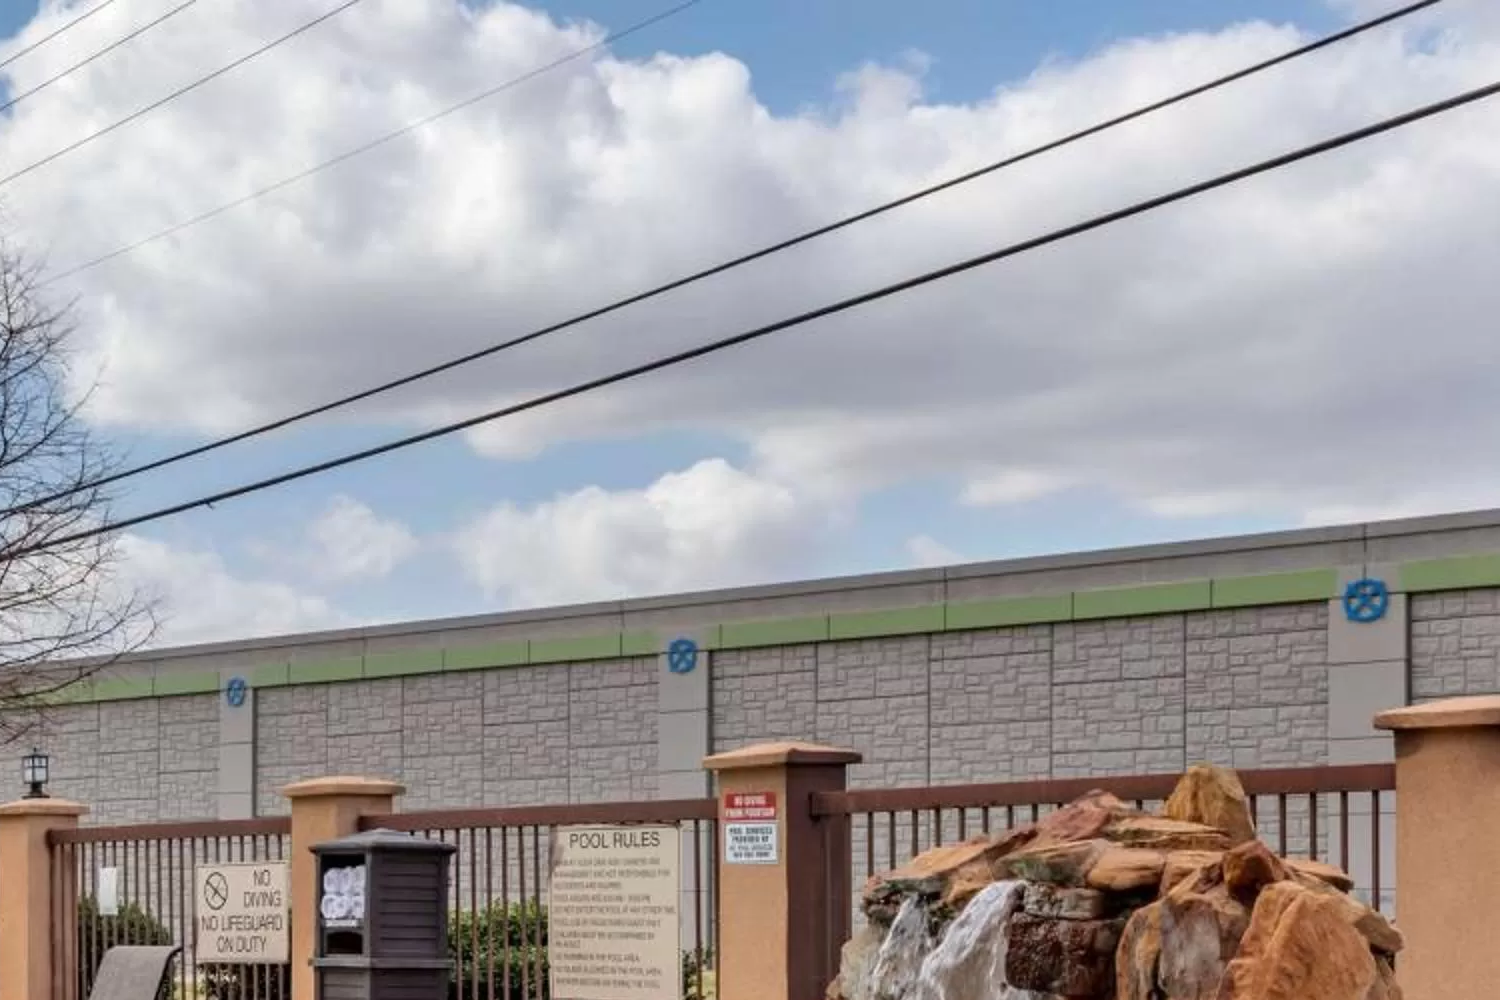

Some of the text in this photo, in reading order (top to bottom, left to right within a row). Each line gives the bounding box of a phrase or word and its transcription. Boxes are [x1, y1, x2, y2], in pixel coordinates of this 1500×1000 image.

[569, 831, 660, 849] POOL RULES
[252, 869, 271, 887] NO
[244, 890, 282, 908] DIVING
[201, 914, 283, 931] NO LIFEGUARD
[216, 935, 267, 953] ON DUTY
